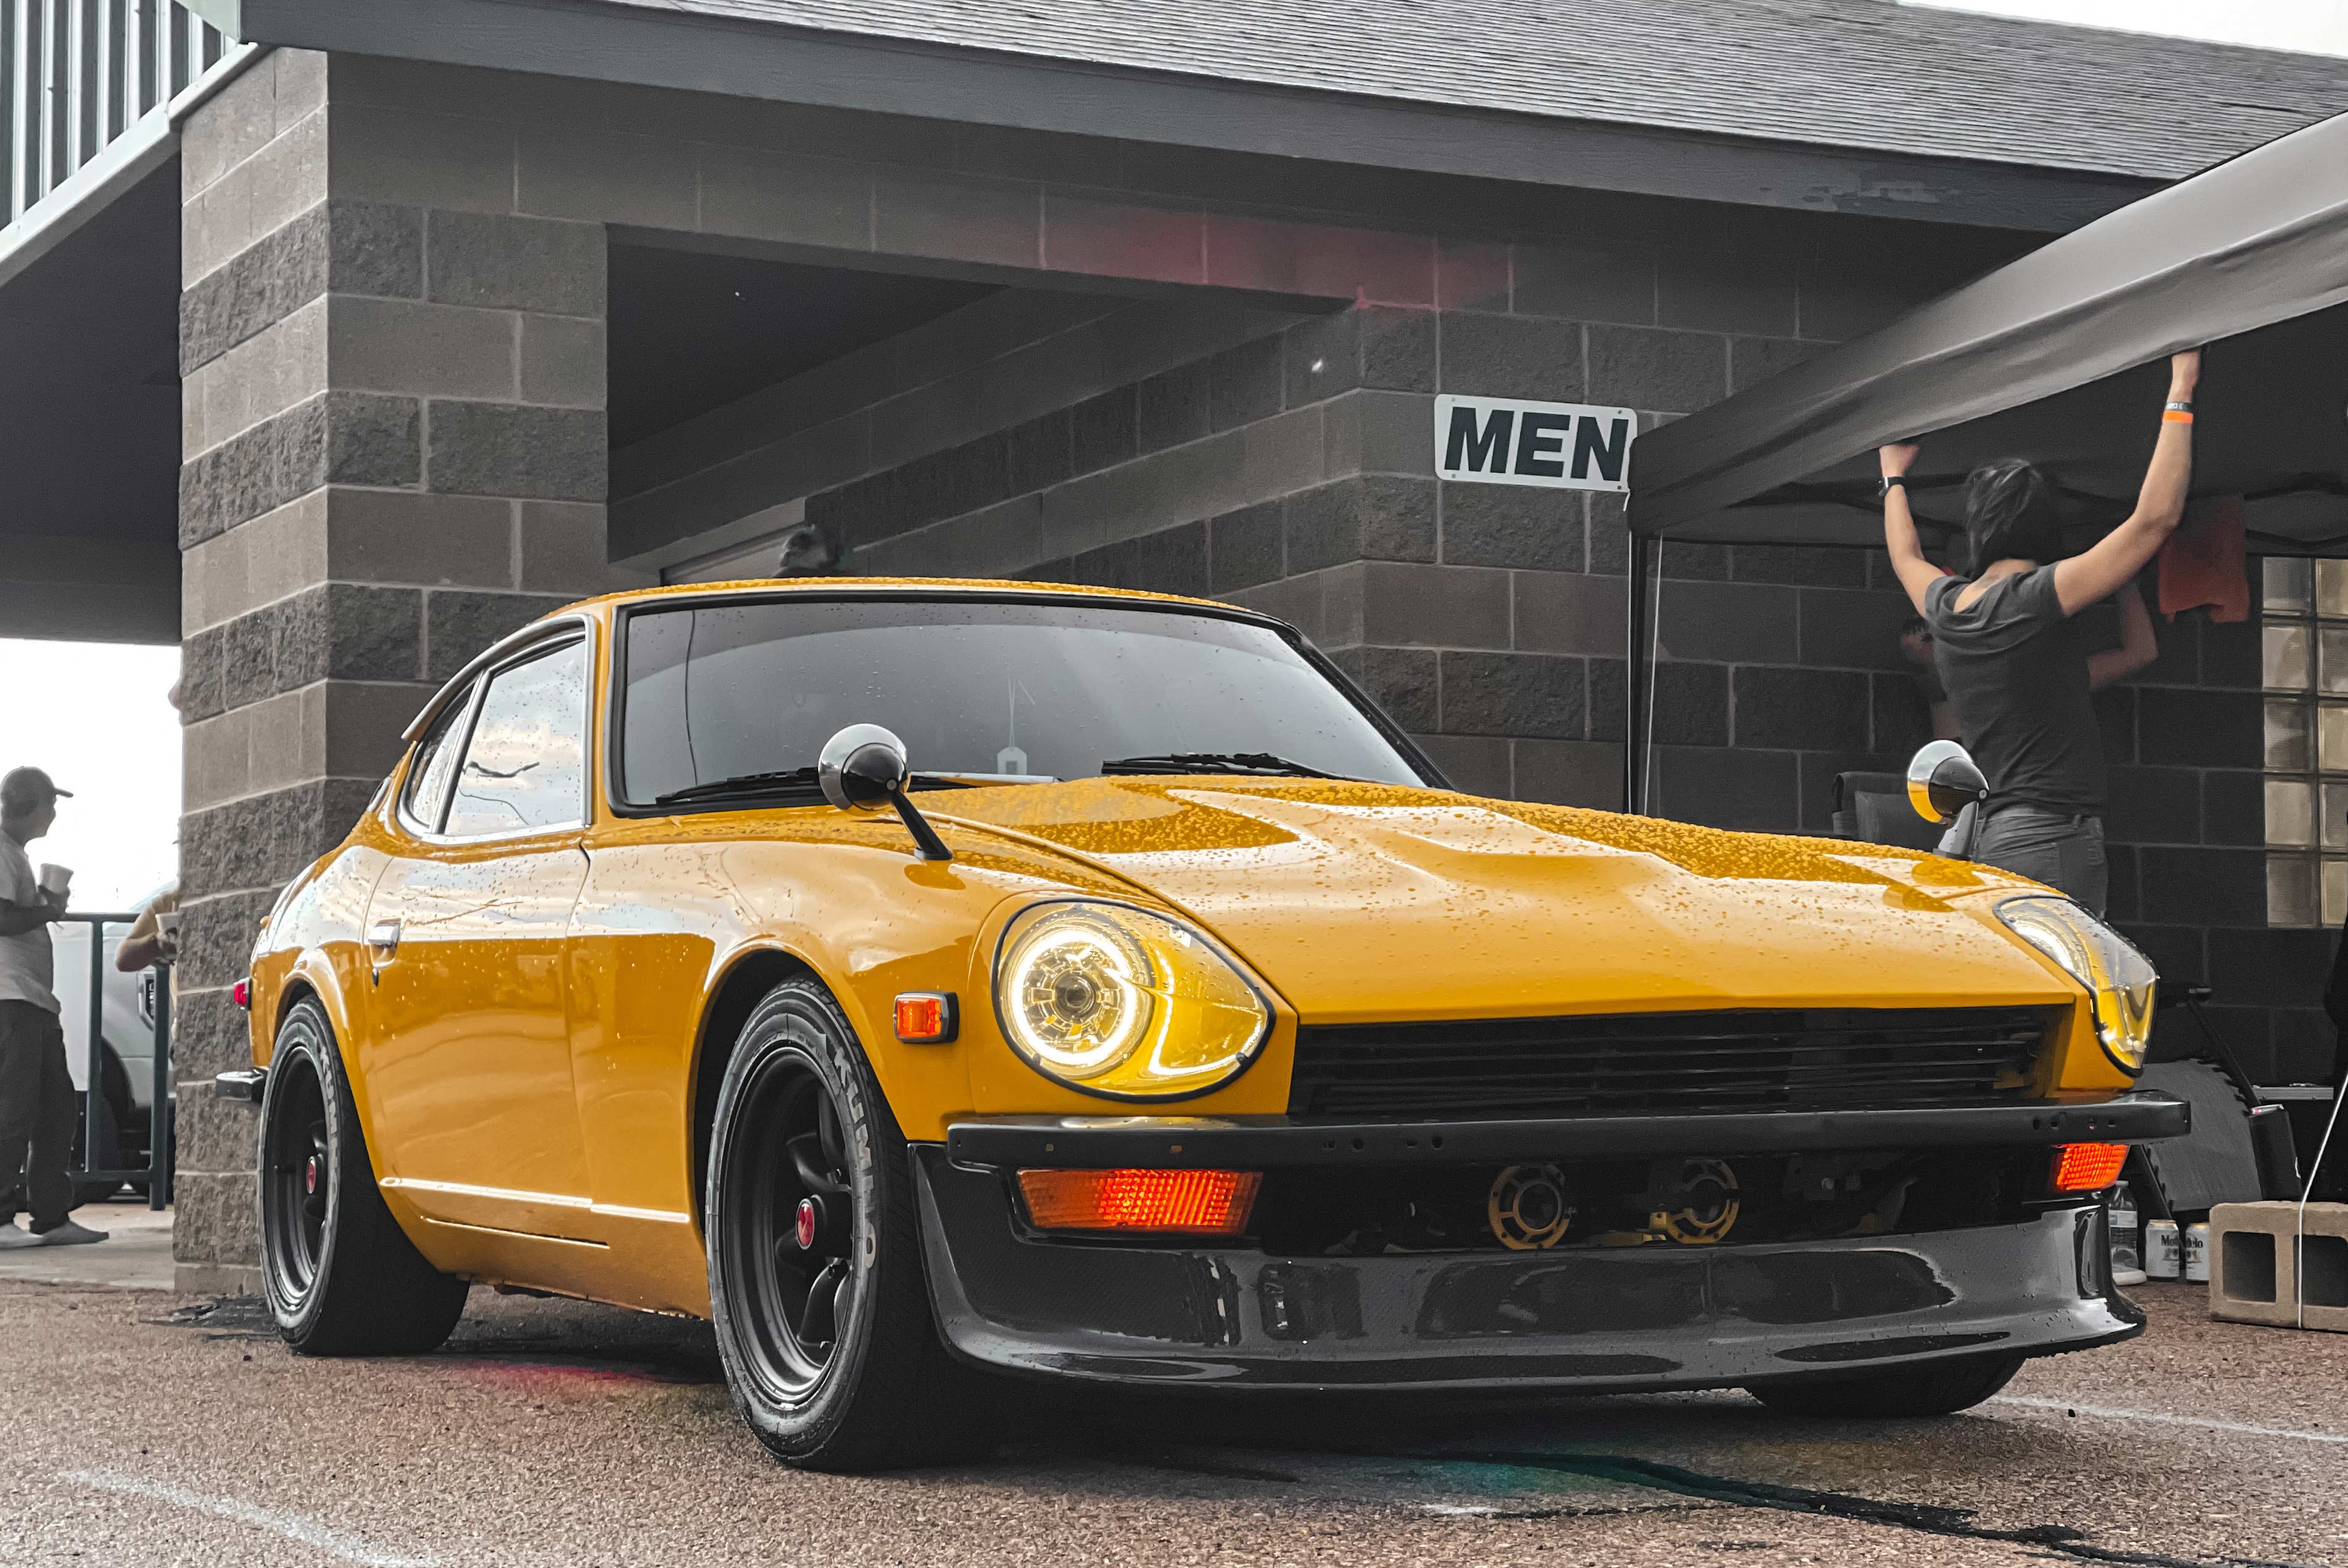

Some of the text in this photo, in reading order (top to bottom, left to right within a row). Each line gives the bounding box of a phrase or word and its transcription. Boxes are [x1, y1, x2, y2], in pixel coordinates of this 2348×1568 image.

[1444, 407, 1629, 481] MEN
[320, 1046, 338, 1205] KUMHO
[834, 1047, 876, 1268] KUMHO
